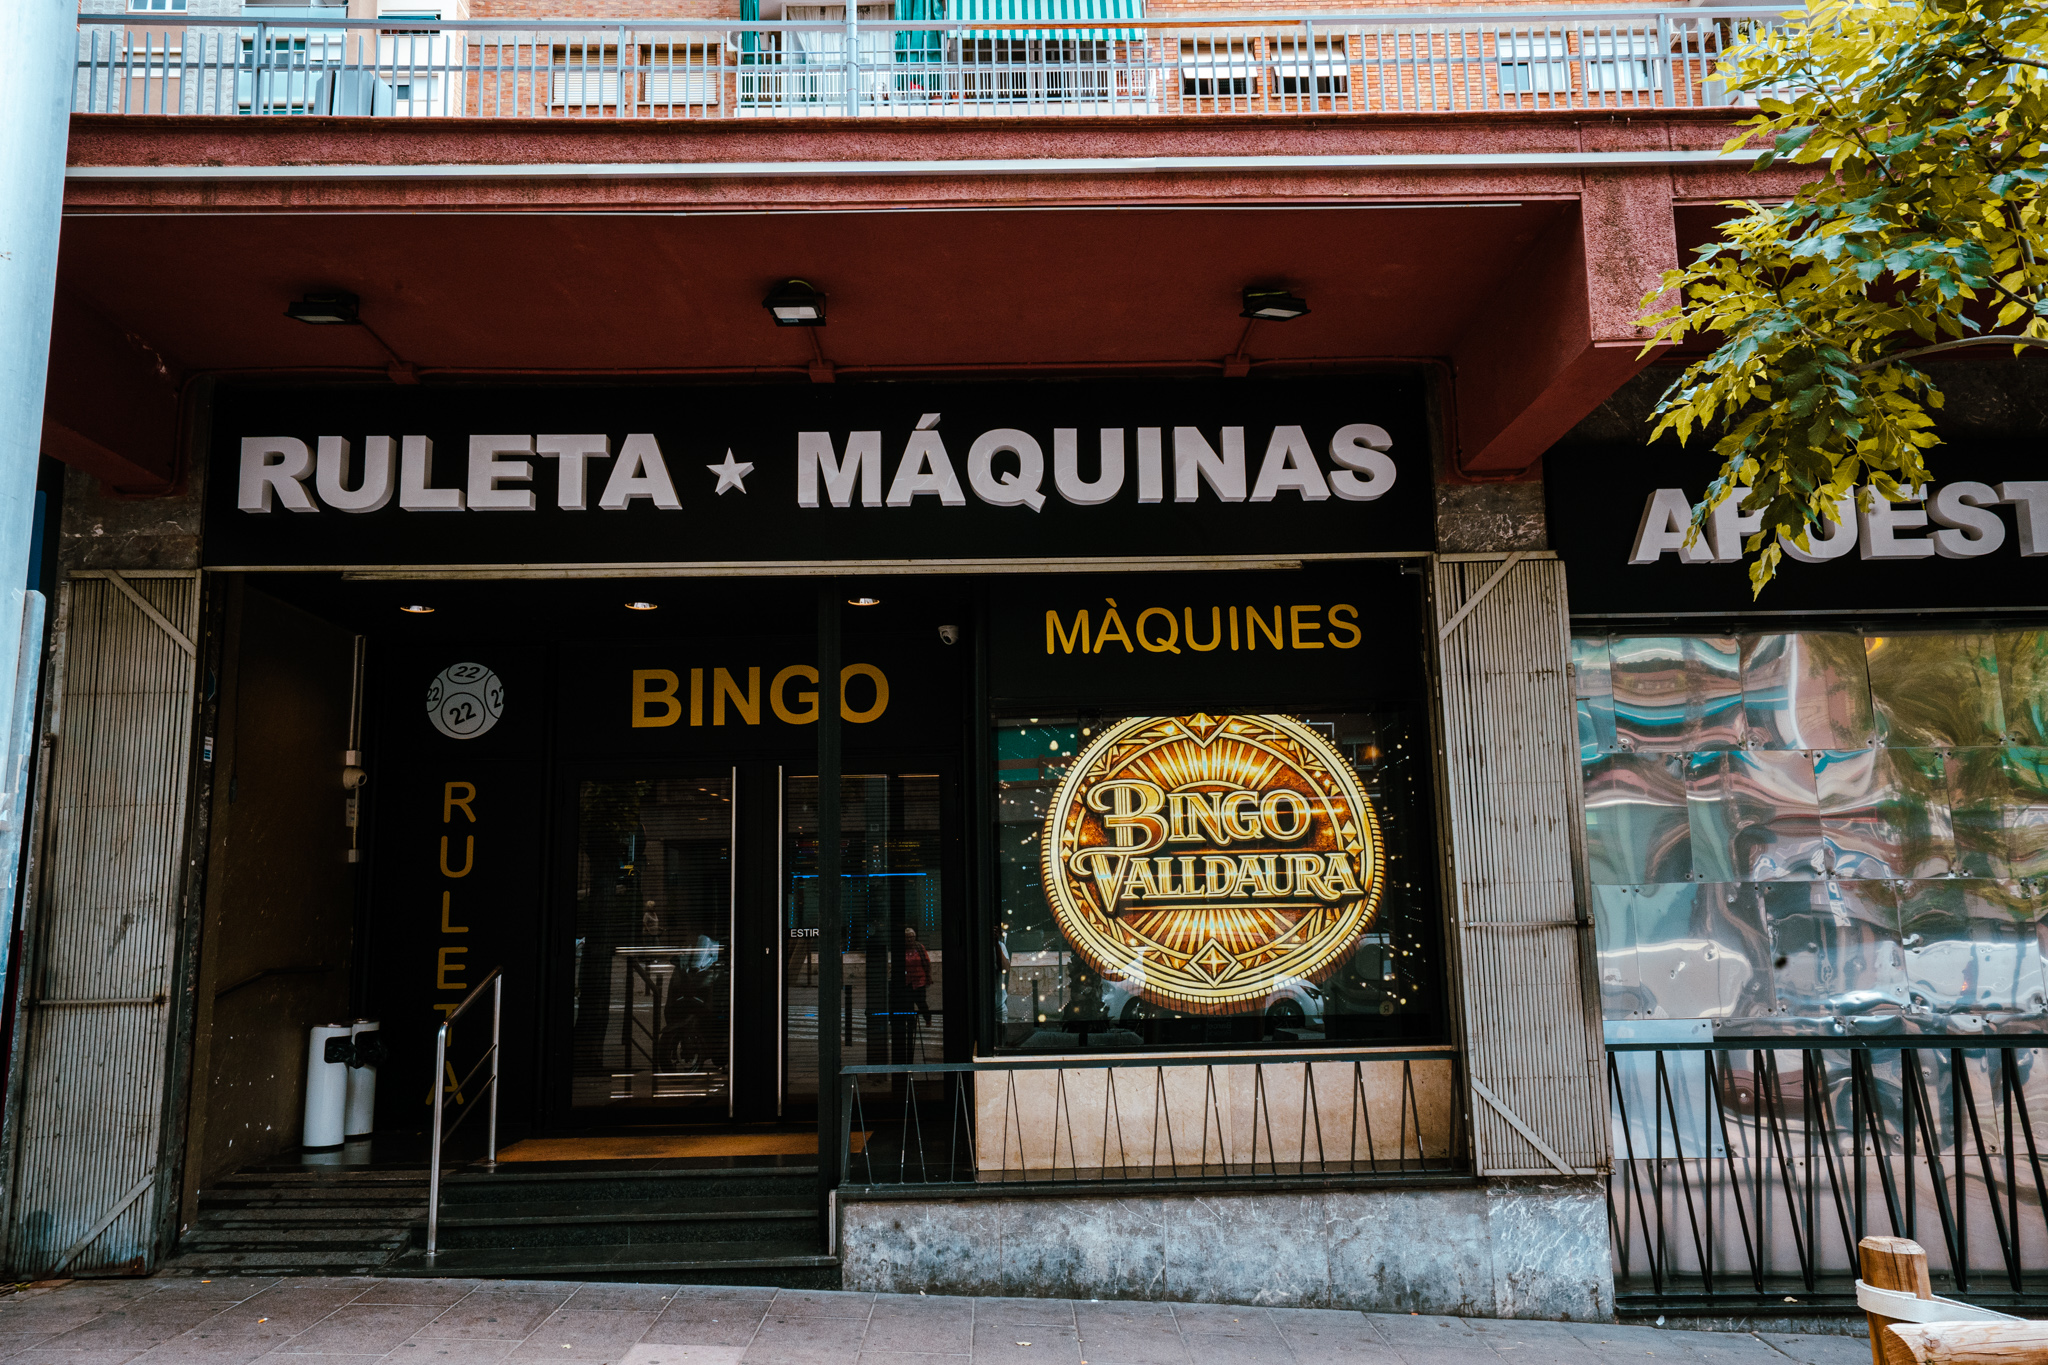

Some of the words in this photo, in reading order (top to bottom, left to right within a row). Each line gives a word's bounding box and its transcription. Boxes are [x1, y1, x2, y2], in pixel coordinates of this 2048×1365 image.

[237, 433, 683, 514] RULETA
[796, 412, 1398, 514] MÁQUINAS
[1045, 597, 1362, 655] MÀQUINES
[454, 665, 480, 679] 22
[631, 662, 890, 728] BINGO
[449, 702, 476, 726] 22
[1086, 779, 1313, 855] BINGO
[1069, 844, 1366, 915] VALLDAURA
